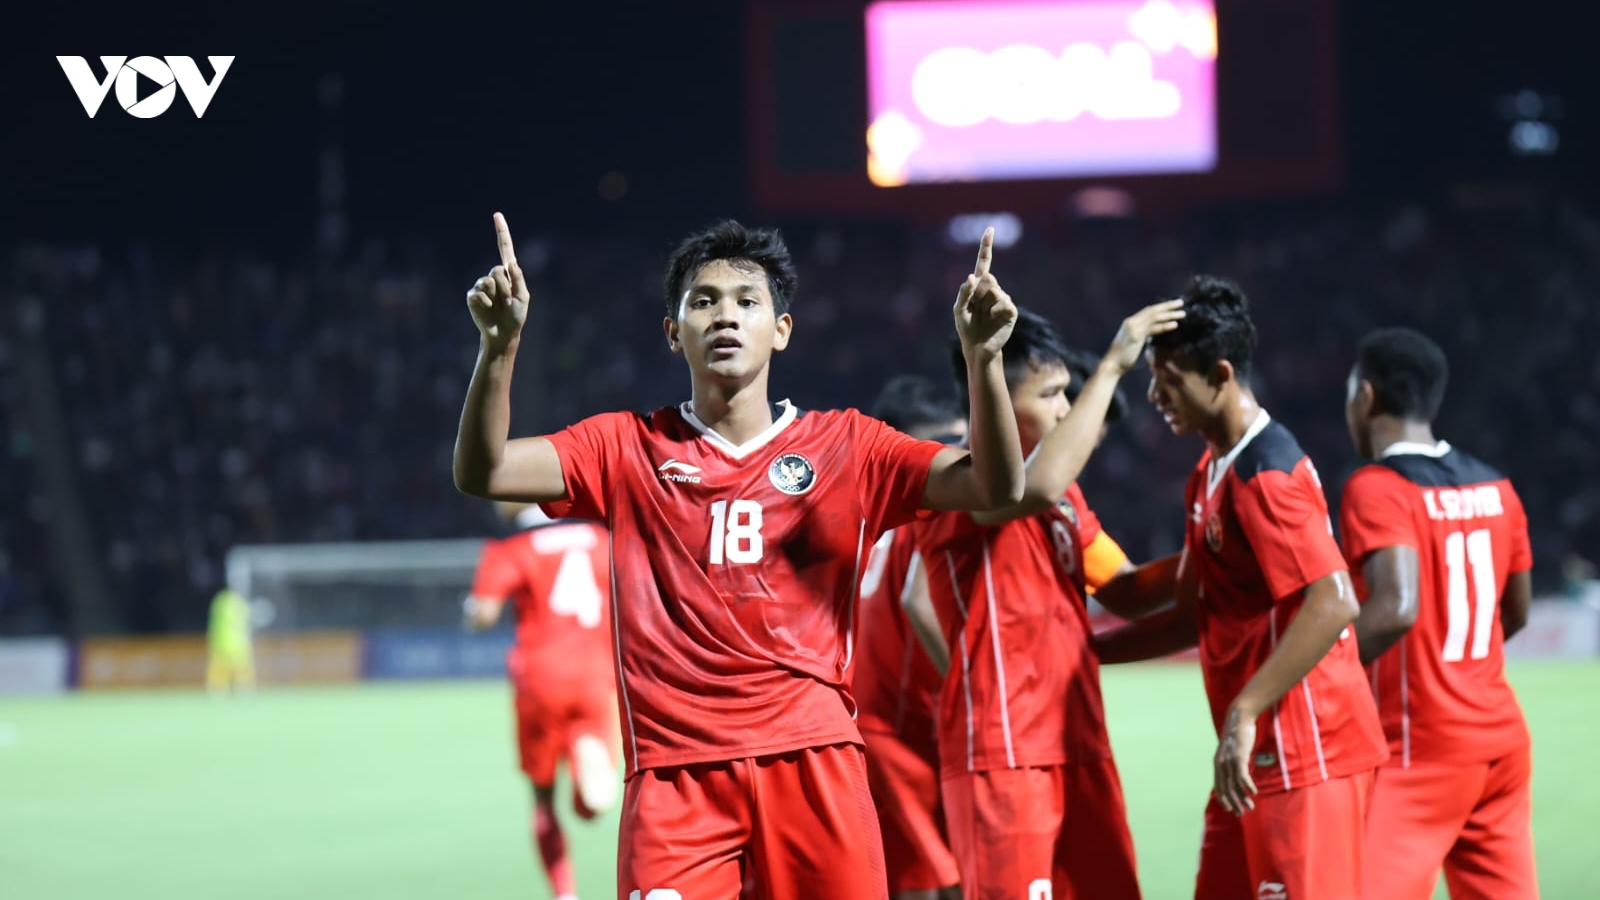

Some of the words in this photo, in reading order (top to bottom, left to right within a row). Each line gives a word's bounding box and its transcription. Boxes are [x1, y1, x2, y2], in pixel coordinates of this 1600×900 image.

[709, 499, 764, 565] 18
[547, 548, 603, 629] 4
[1442, 529, 1497, 662] 11
